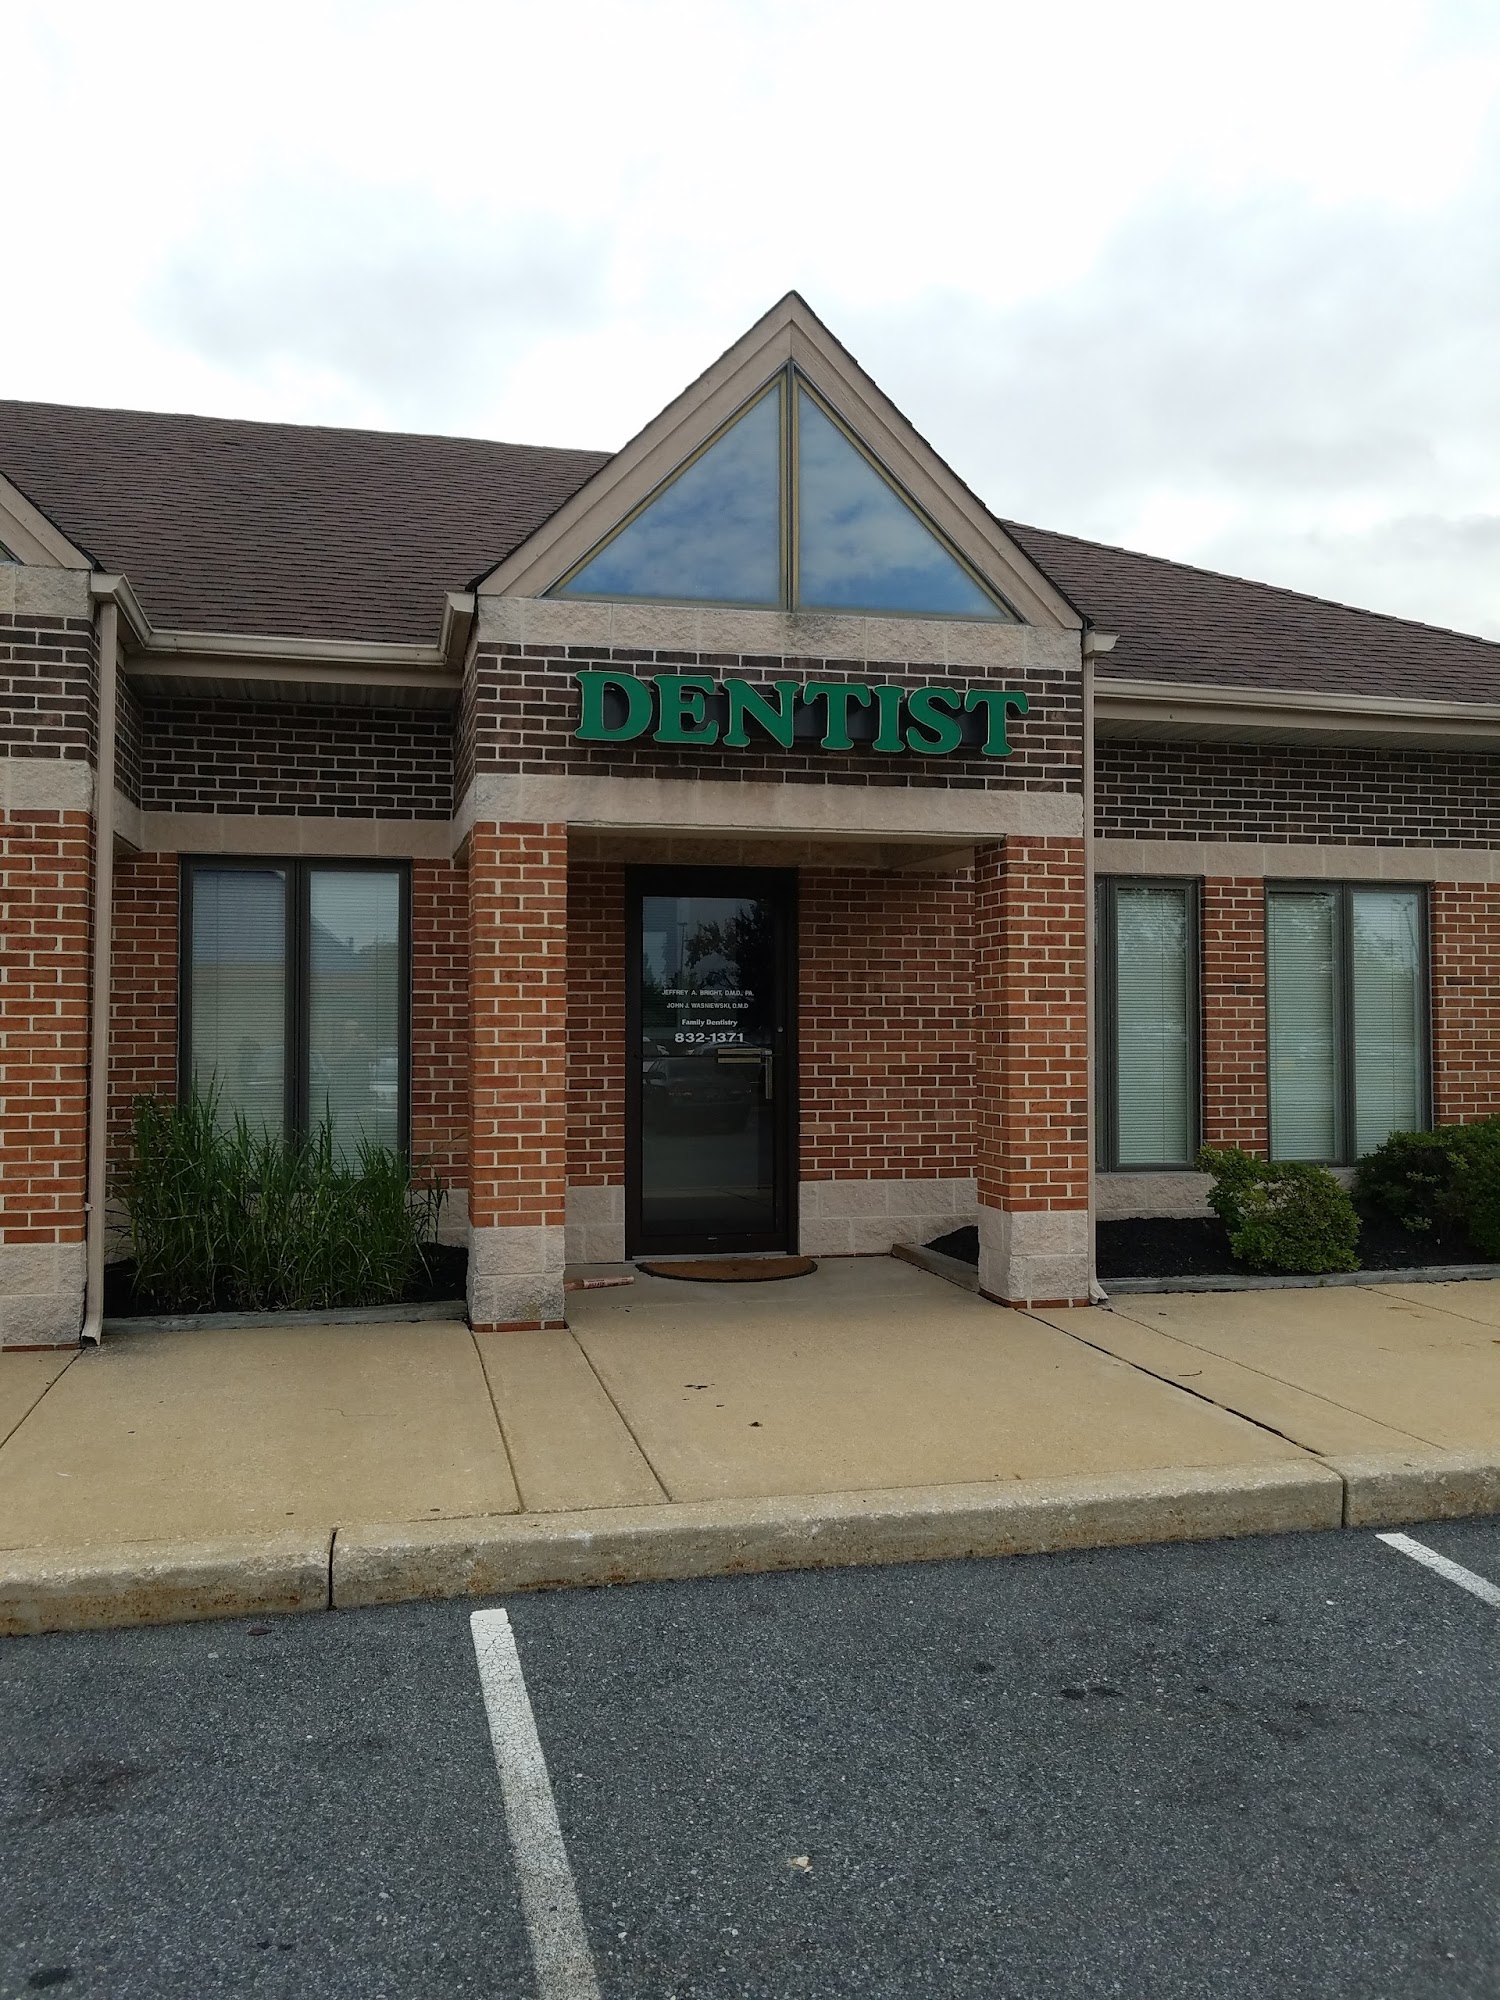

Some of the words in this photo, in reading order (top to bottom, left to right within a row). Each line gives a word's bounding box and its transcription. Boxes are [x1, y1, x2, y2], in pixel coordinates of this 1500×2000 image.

[574, 670, 1030, 757] DENTIST
[700, 989, 723, 997] BRIGHT,
[690, 1002, 731, 1010] WASNIEWSKI,
[681, 1019, 705, 1028] Family
[706, 1019, 738, 1028] Dentistry
[674, 1032, 744, 1043] 832-1371
